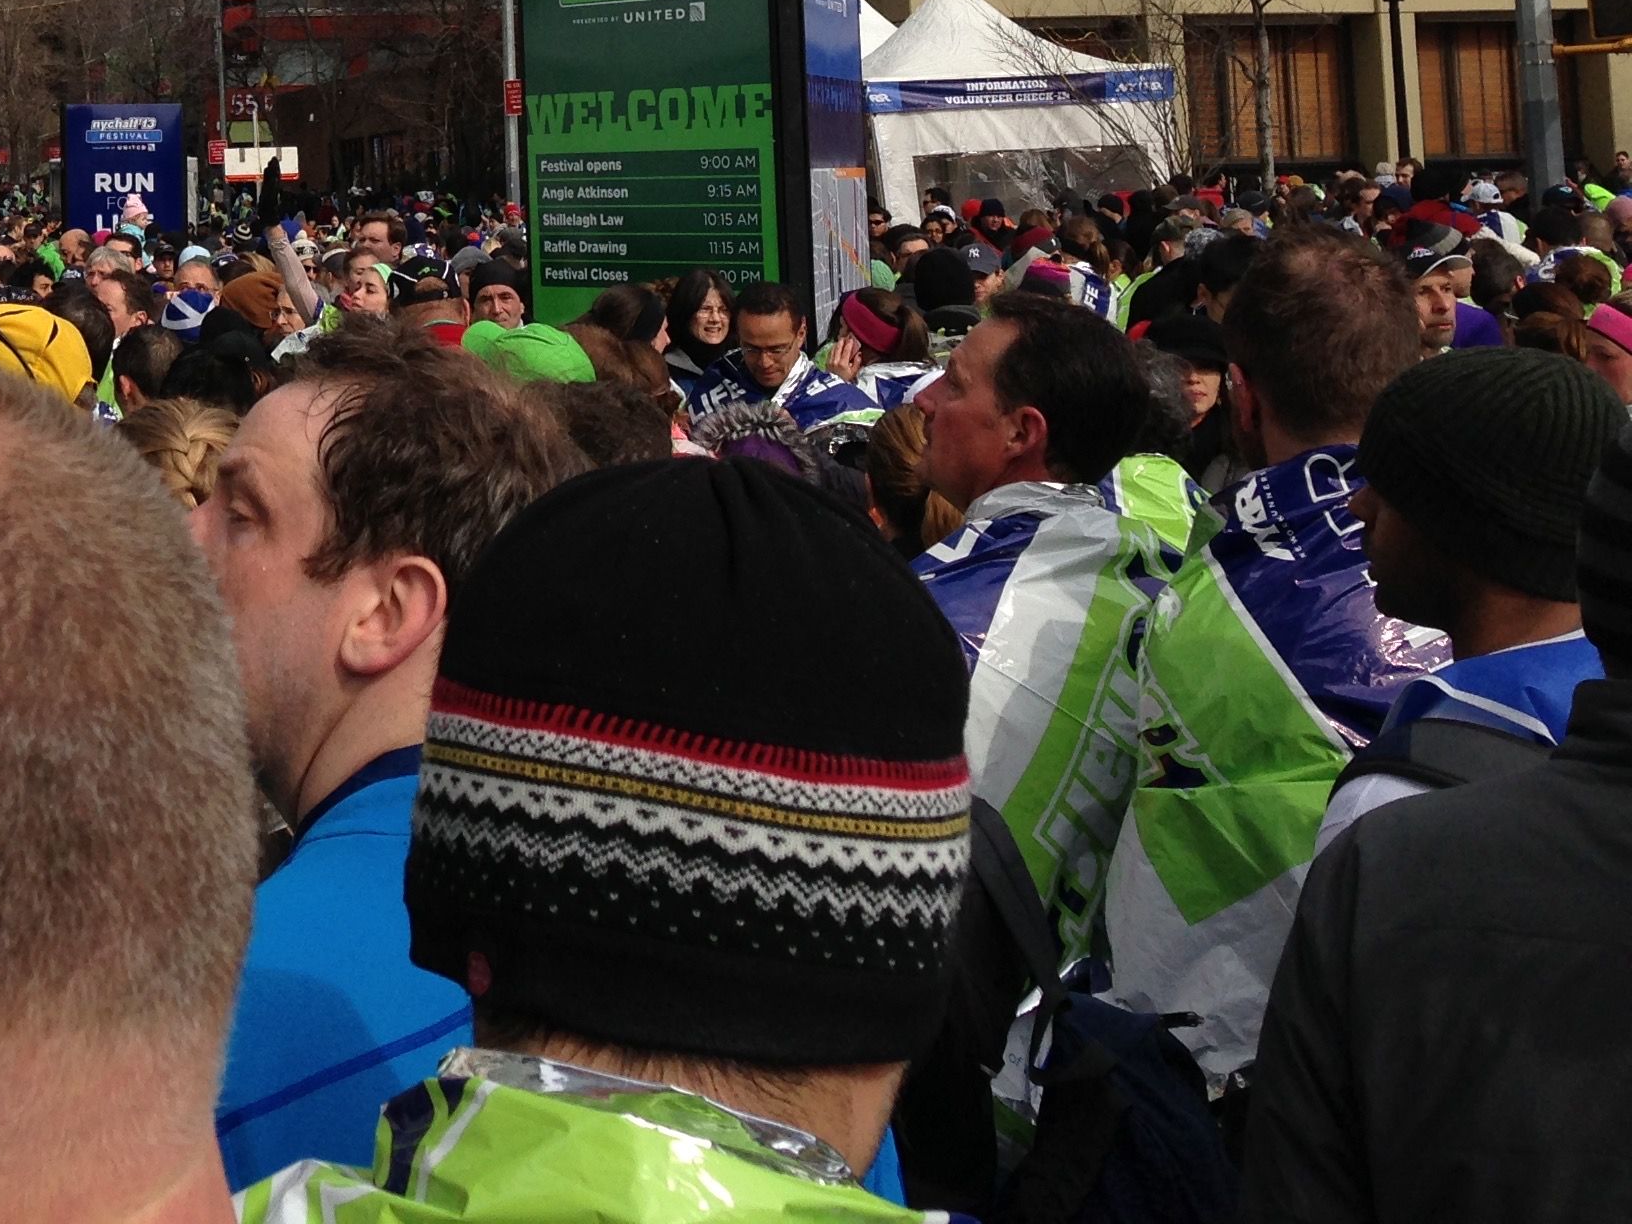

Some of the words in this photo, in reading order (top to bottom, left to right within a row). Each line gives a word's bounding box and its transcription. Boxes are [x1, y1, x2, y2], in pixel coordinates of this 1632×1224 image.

[623, 8, 686, 24] UNITED
[966, 79, 1048, 91] INFORMATION
[944, 94, 1014, 105] VOLUNTEER
[1015, 91, 1070, 103] CHECK-IN
[525, 83, 773, 134] WELCOME
[540, 160, 584, 173] Festival
[586, 159, 622, 173] opens
[700, 155, 730, 169] 9:00
[735, 155, 756, 168] AM
[94, 172, 155, 193] RUN
[577, 186, 629, 199] Atkinson
[707, 184, 732, 198] 9:15
[736, 184, 757, 197] AM
[542, 213, 597, 228] Shillelagh
[600, 213, 624, 226] Law
[703, 212, 733, 226] 10:15
[738, 212, 759, 225] AM
[544, 240, 576, 254] Raffle
[579, 241, 628, 256] Drawing
[709, 241, 734, 254] 11:15
[739, 241, 760, 254] AM
[545, 267, 587, 280] Festival
[590, 268, 629, 282] Closes
[741, 270, 761, 283] PM
[687, 378, 747, 425] LIFE
